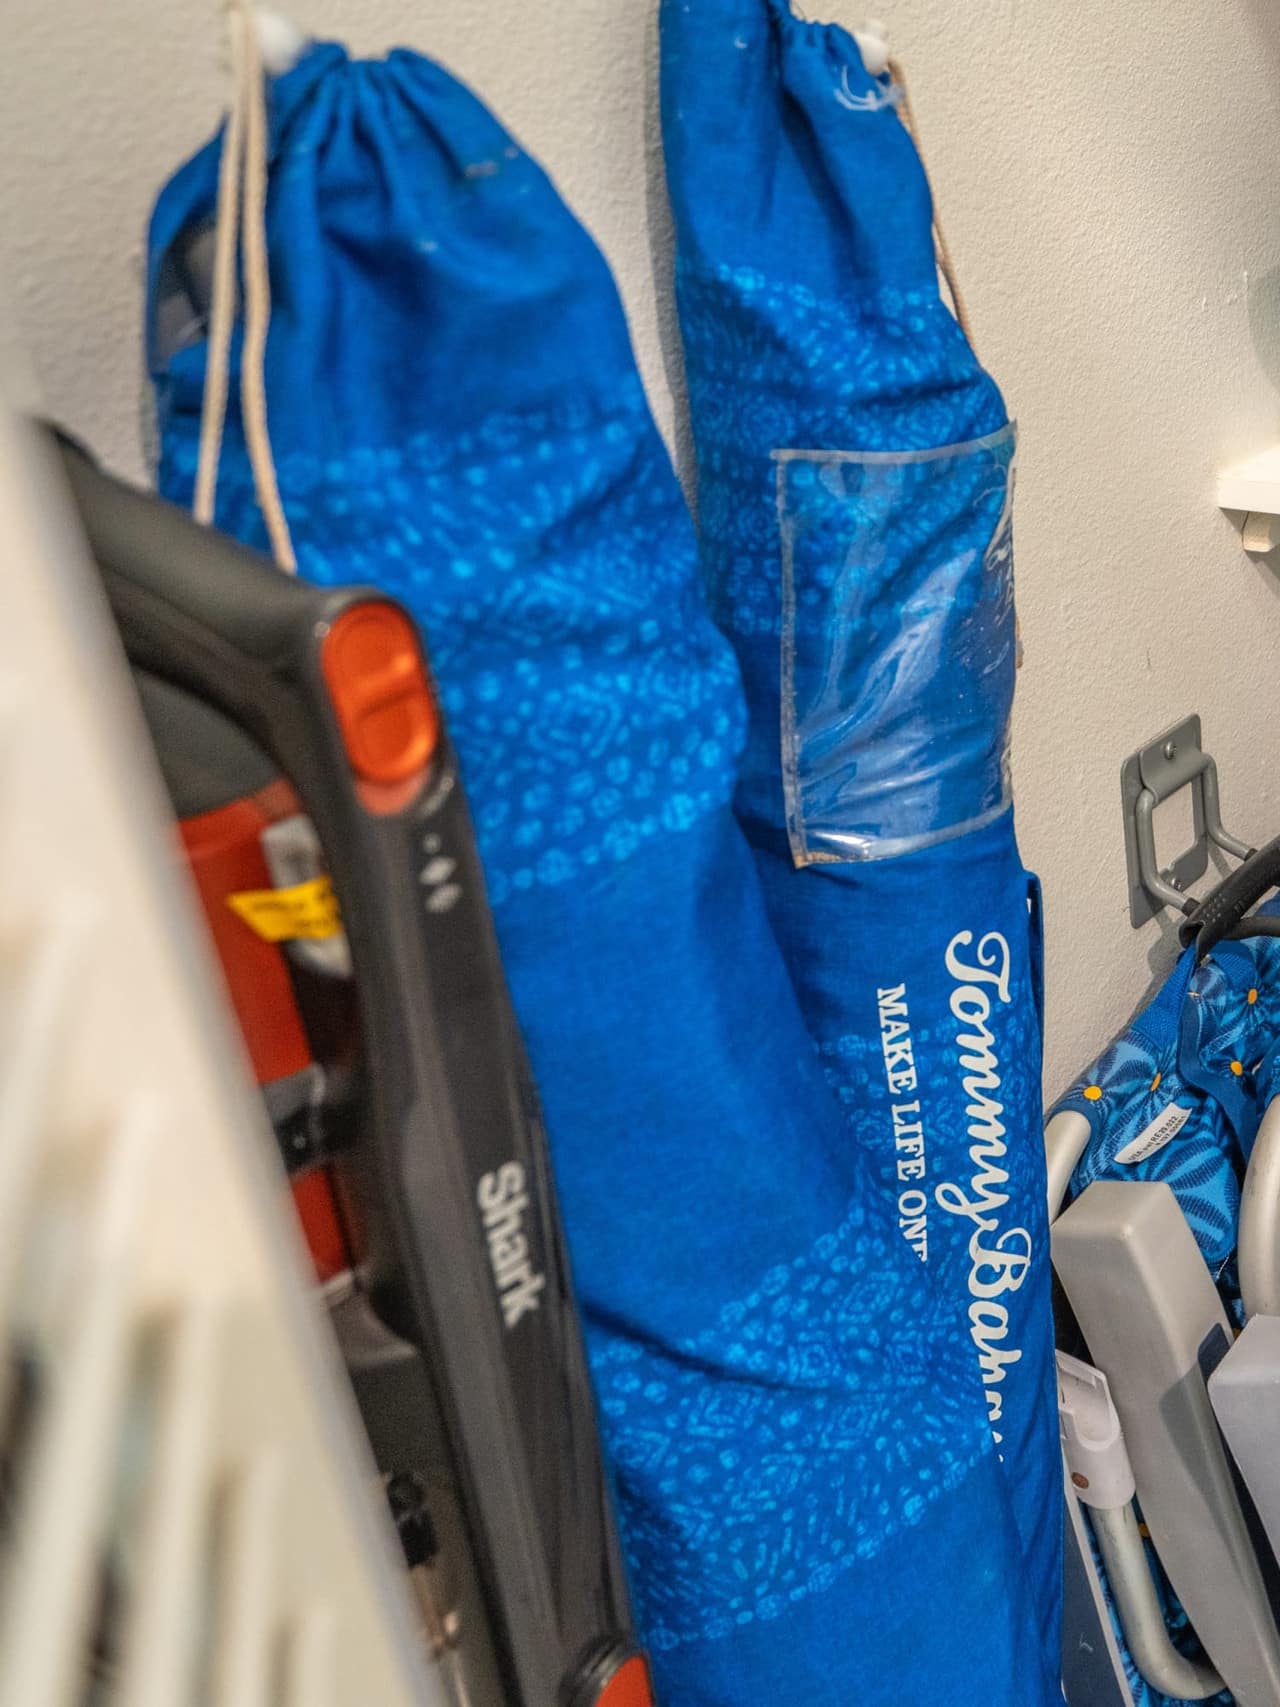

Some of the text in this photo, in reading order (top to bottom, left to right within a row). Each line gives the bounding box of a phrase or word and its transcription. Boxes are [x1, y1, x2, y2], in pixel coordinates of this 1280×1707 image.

[877, 983, 917, 1094] MAKE
[935, 930, 1011, 1231] Tommy
[891, 1100, 925, 1181] LIFE
[478, 1161, 546, 1328] Shark
